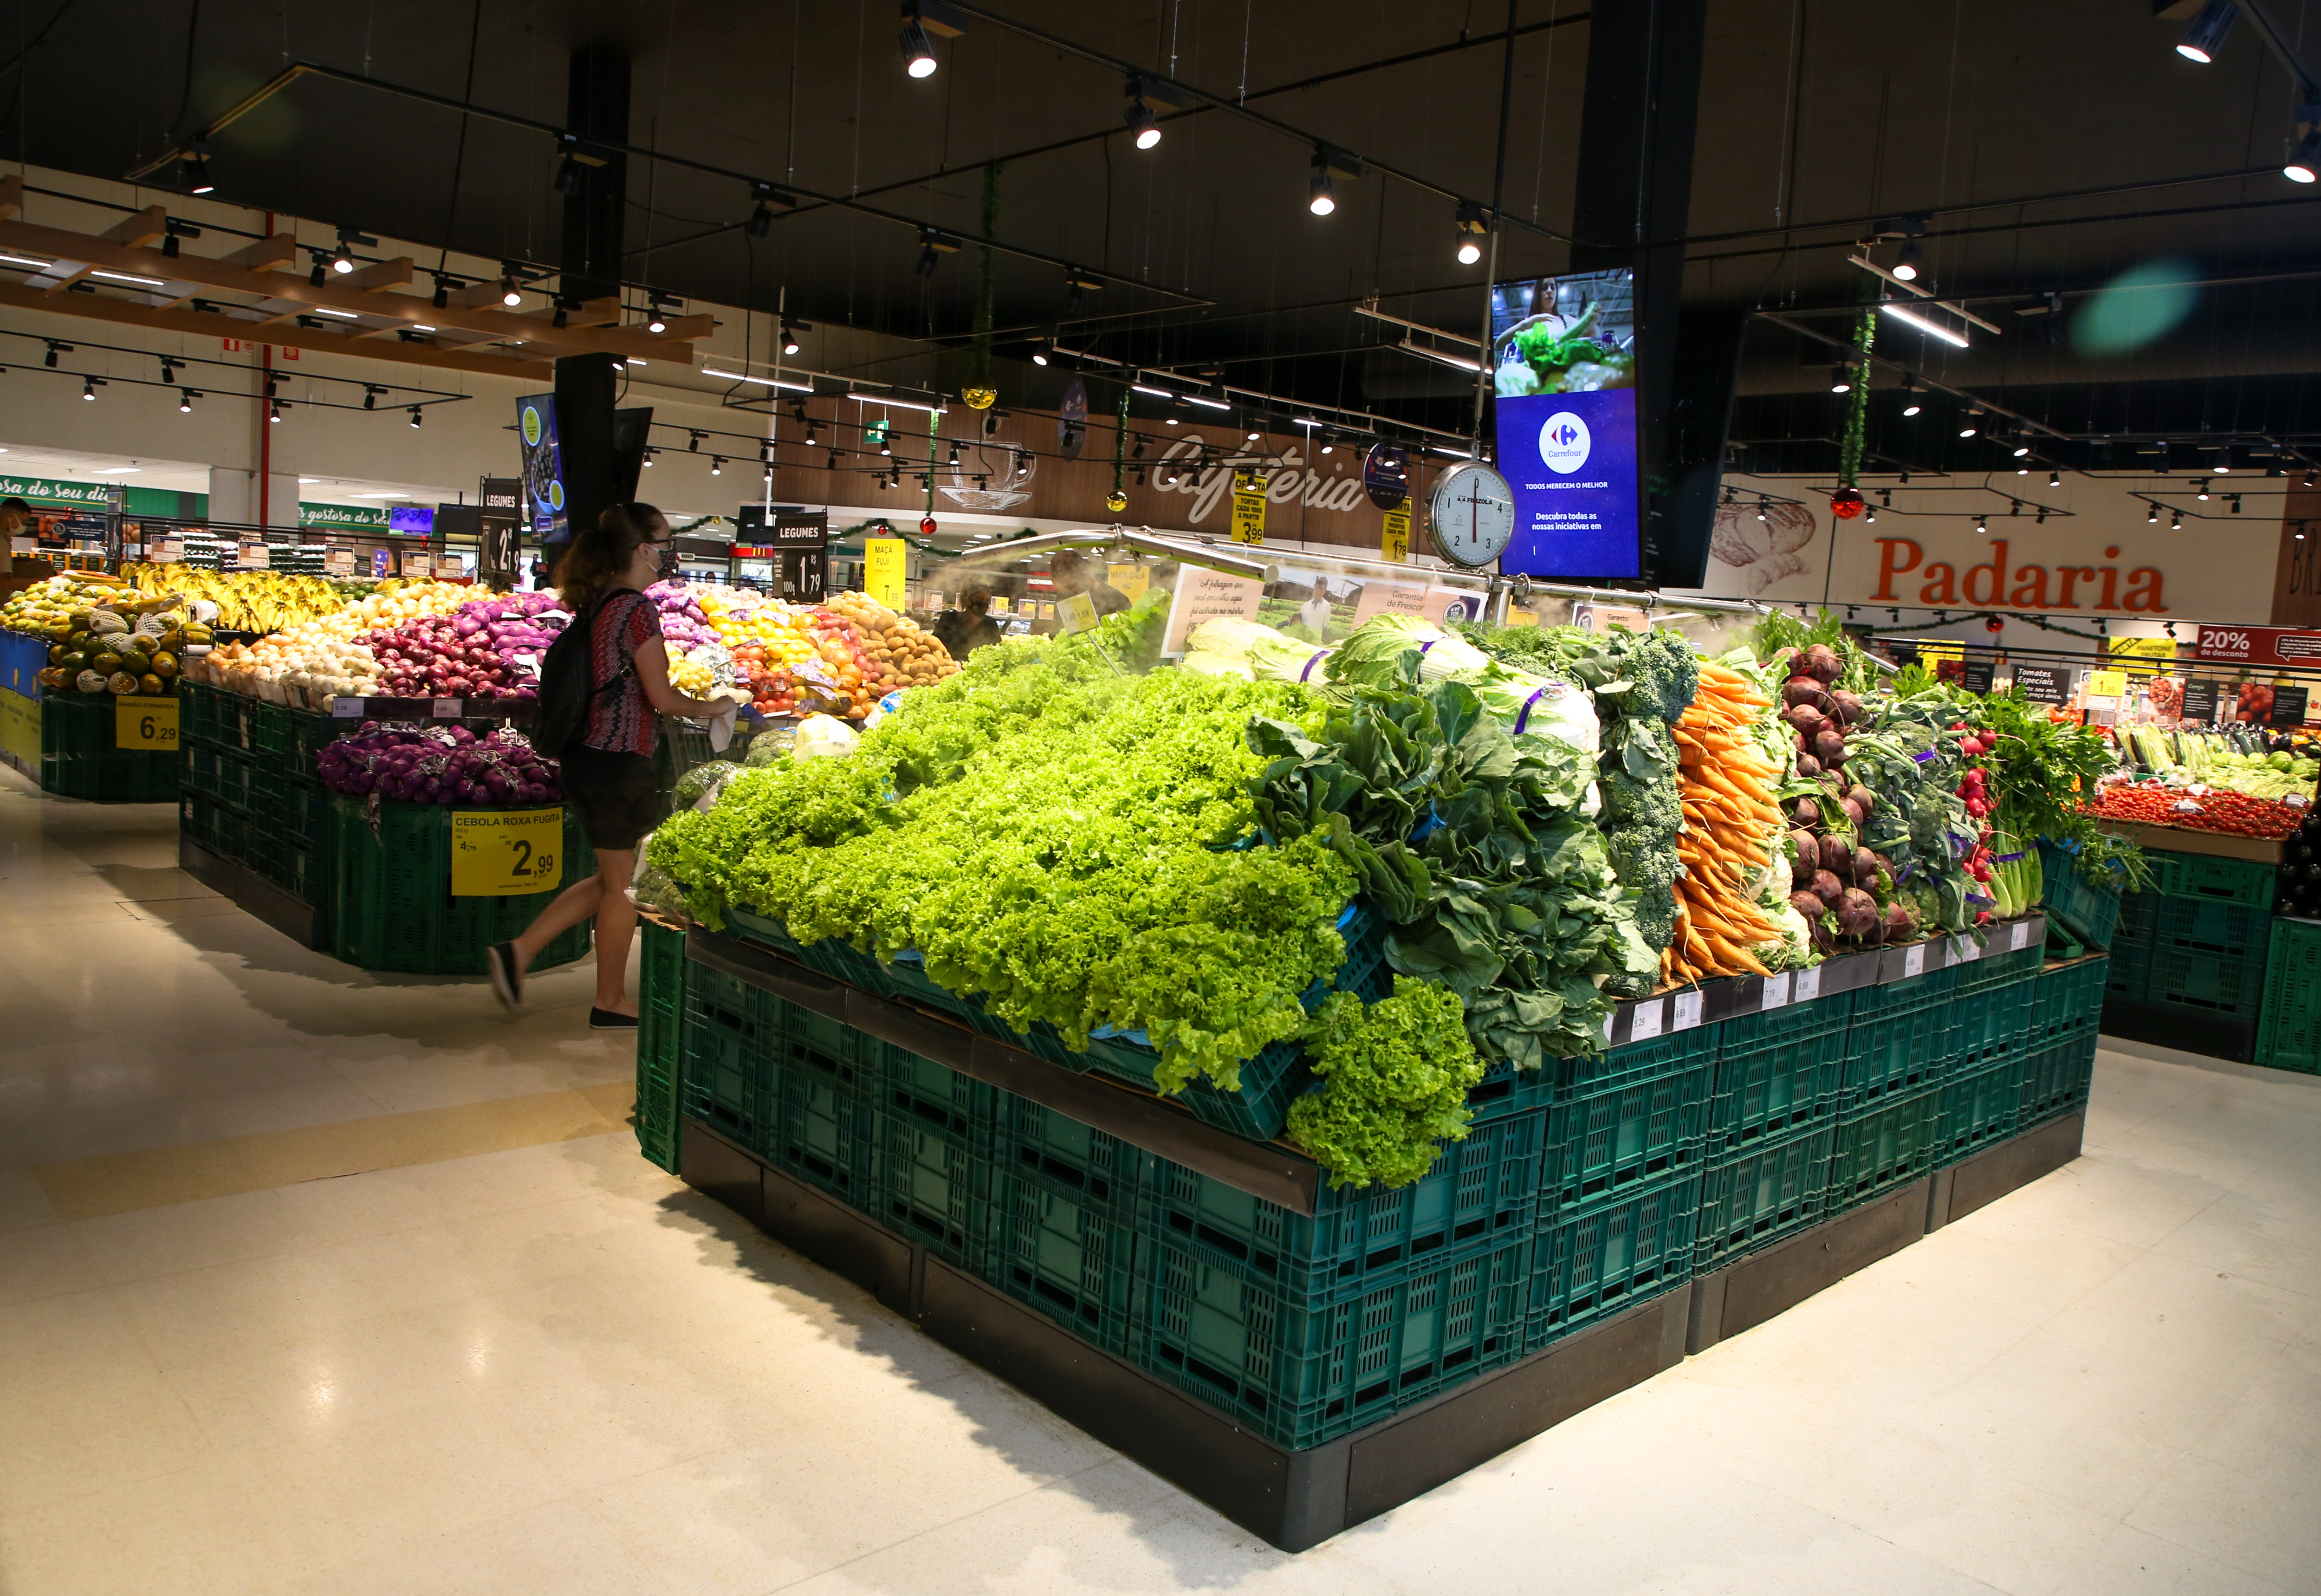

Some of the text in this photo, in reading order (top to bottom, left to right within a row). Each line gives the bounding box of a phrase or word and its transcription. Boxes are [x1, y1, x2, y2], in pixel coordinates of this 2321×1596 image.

[27, 480, 52, 496] do
[54, 484, 85, 499] seu
[1236, 479, 1266, 492] OFTA
[487, 495, 515, 508] LEGUMES
[1498, 503, 1502, 513] 4
[308, 508, 353, 525] gostosa
[355, 512, 370, 524] do
[780, 527, 819, 538] LEGUMES
[1455, 536, 1459, 546] 2
[1486, 538, 1491, 549] 3
[875, 545, 892, 556] MAÇÃ
[1868, 538, 2169, 613] Padaria
[1230, 595, 1243, 604] aqui
[1393, 591, 1423, 602] Garantia
[1398, 601, 1424, 611] Frescor
[1608, 614, 1629, 622] Garantia
[2201, 631, 2250, 650] 20%
[2212, 649, 2248, 658] desconto
[2018, 668, 2052, 677] Tomates
[2016, 676, 2054, 685] Especiais
[140, 715, 176, 742] 6,29
[456, 814, 560, 826] CEBOLA ROXA FUGITA
[512, 840, 553, 878] 2,99
[1634, 1017, 1645, 1028] 5,29
